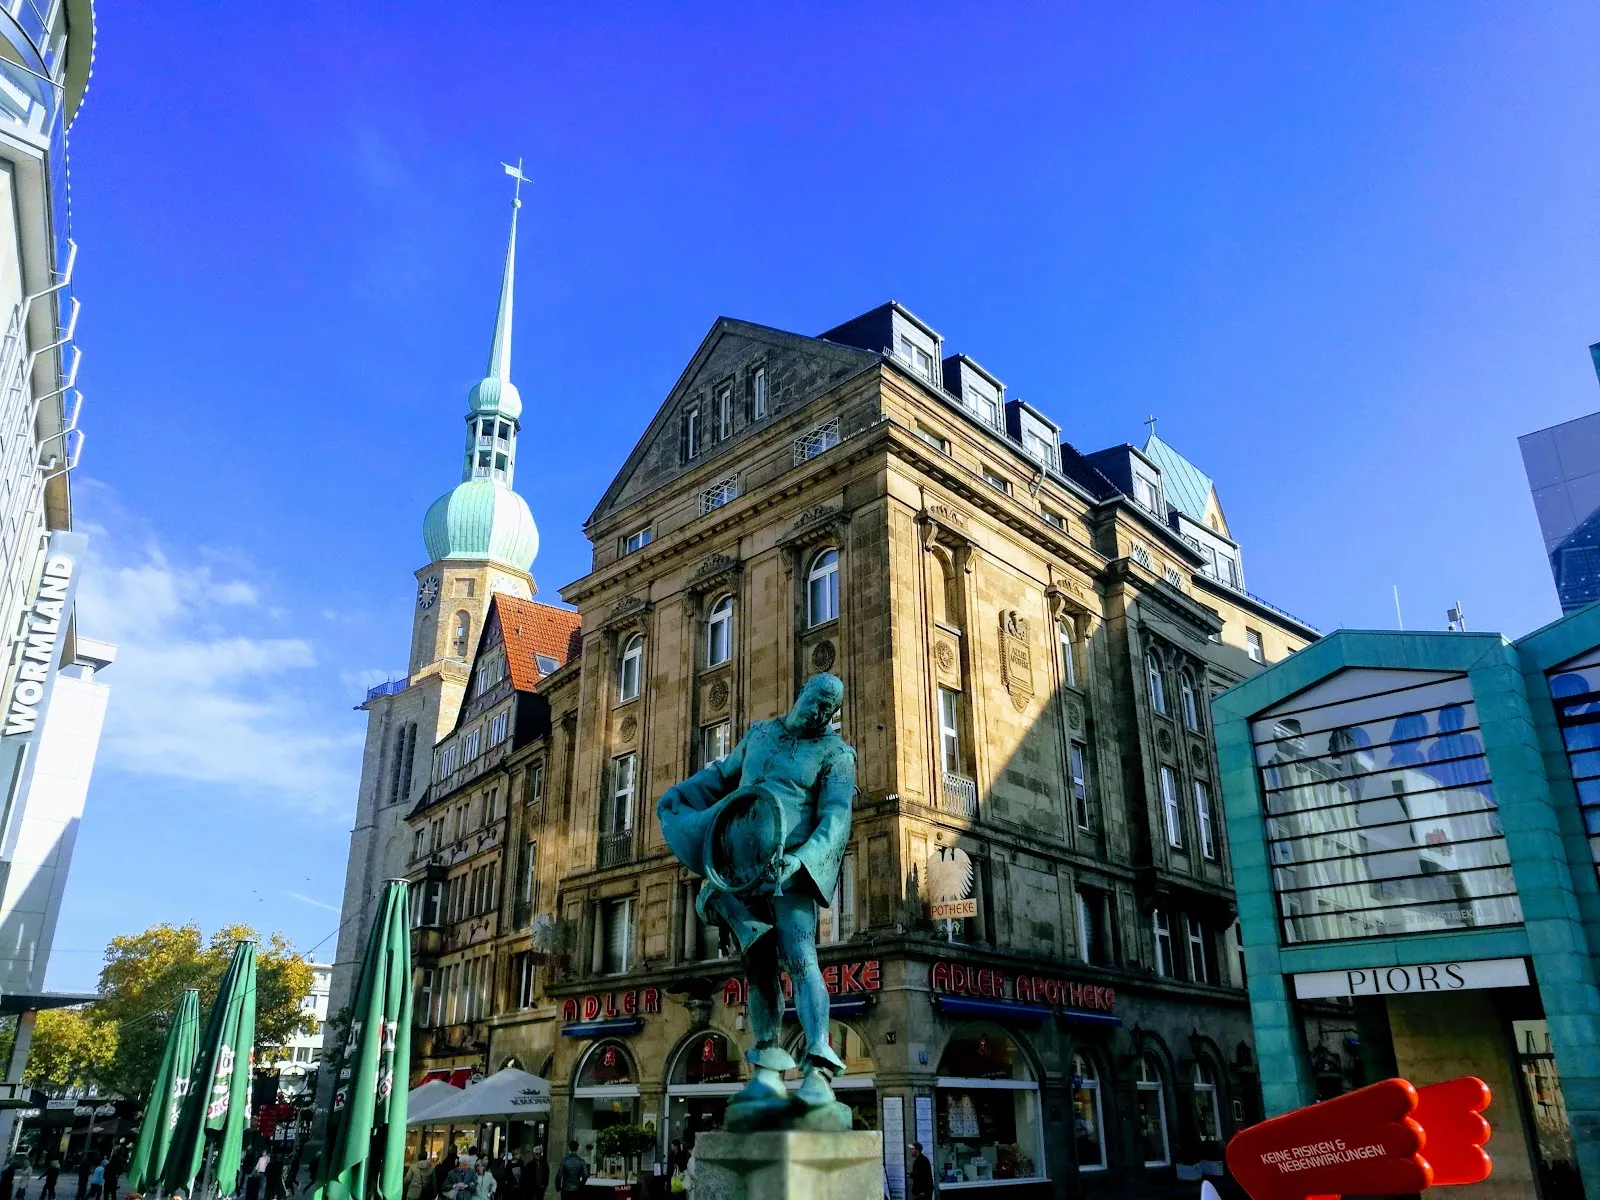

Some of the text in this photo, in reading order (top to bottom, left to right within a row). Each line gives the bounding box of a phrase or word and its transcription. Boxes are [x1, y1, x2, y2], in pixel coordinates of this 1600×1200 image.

[5, 555, 74, 737] WORMLAND
[563, 960, 881, 1021] ADLER ATEKE
[931, 961, 1117, 1013] ADLER APOTHEKE
[1346, 963, 1466, 995] PIORS
[1260, 1138, 1347, 1166] KEINE RISIKEN &
[1277, 1143, 1388, 1174] NEBENWIRKUNGEN!
